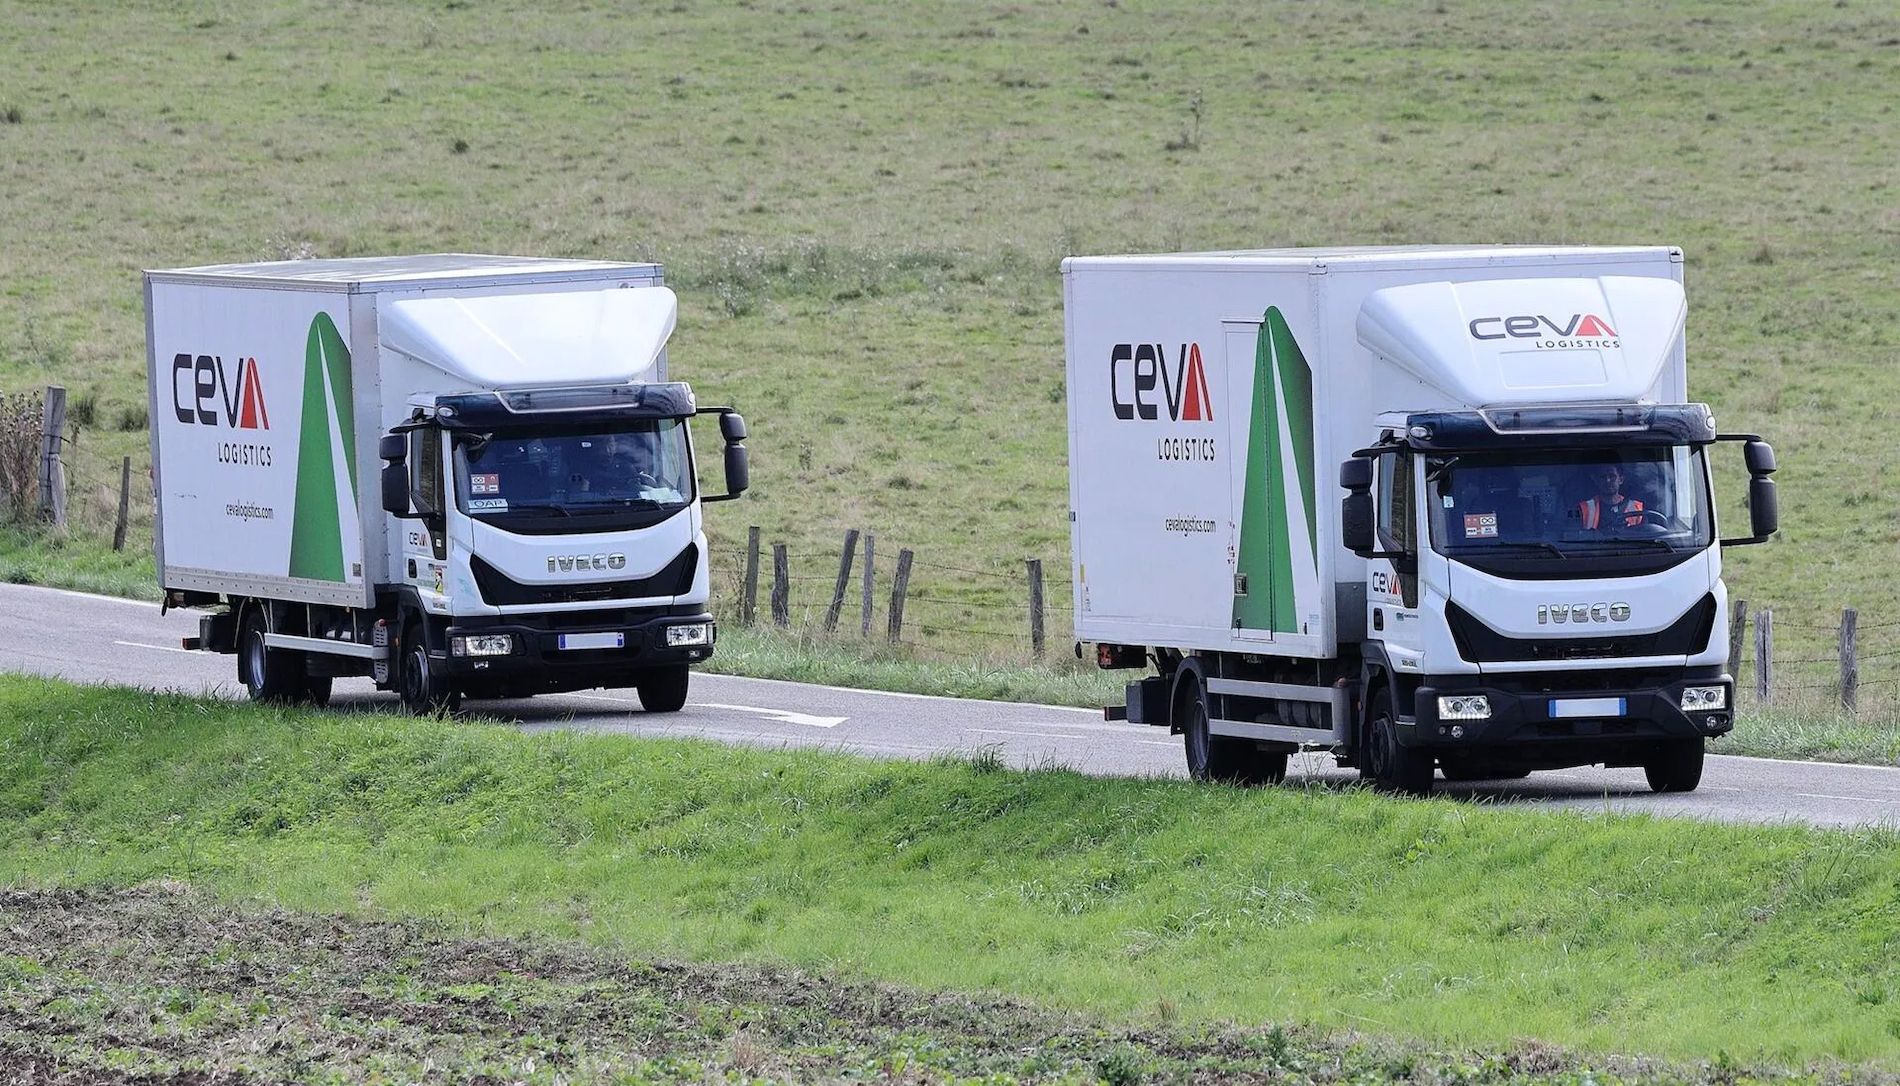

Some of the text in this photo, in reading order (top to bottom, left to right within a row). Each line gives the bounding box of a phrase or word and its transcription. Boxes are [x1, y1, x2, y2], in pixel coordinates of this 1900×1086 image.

[1536, 340, 1620, 349] LOGISTICS
[217, 442, 272, 467] LOGISTICS
[1157, 437, 1215, 462] LOGISTICS
[225, 499, 275, 522] cevalogistics.com
[1165, 513, 1217, 537] cevalogistics.com
[547, 552, 626, 574] IVECO
[1538, 601, 1631, 625] IVECO
